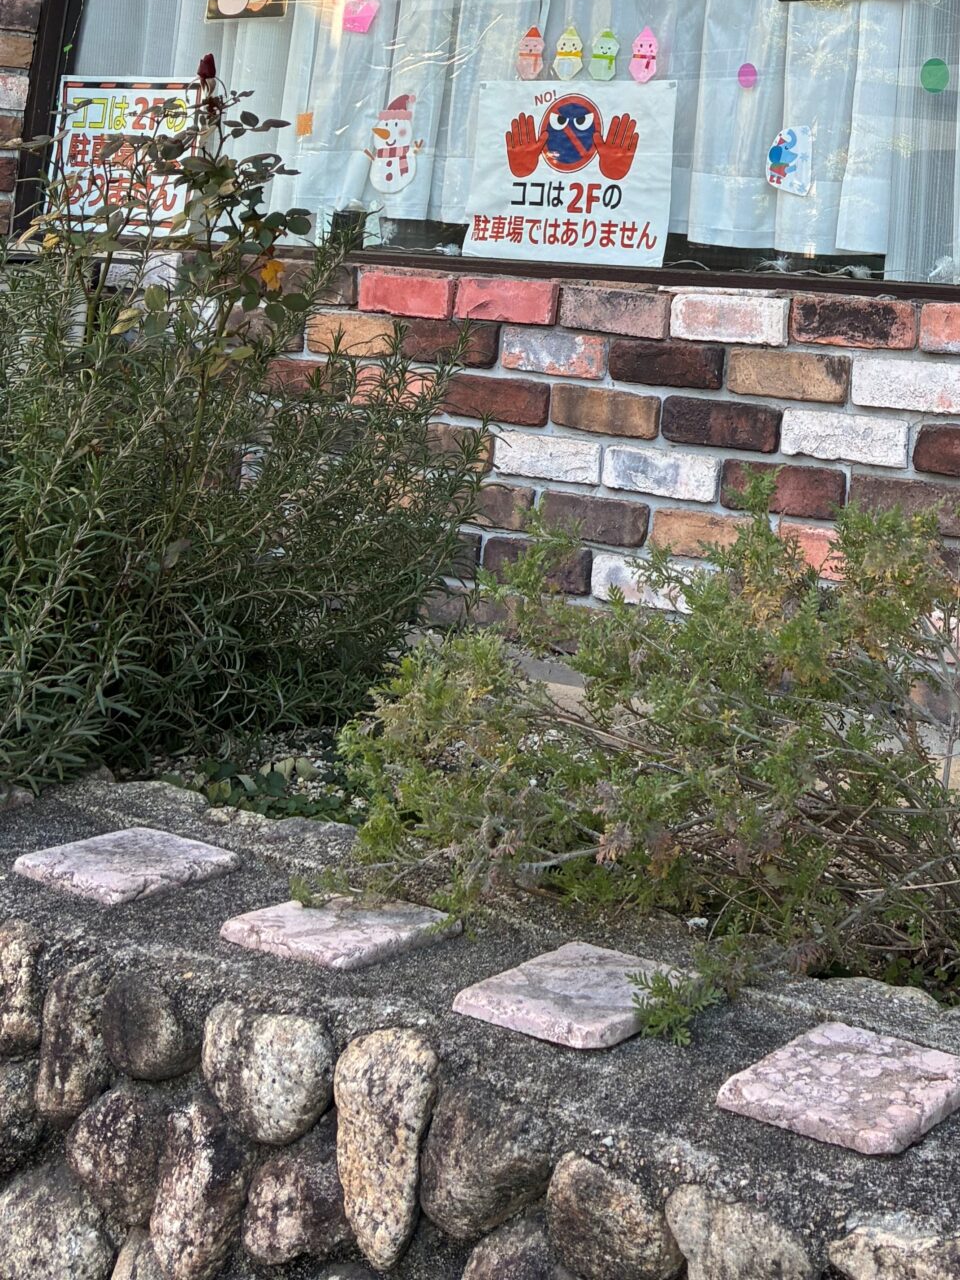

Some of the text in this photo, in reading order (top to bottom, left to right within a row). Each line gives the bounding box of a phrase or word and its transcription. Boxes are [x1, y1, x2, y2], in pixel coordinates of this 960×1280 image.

[534, 90, 558, 107] NO!
[510, 180, 622, 214] ココは2Fの
[471, 214, 658, 250] 駐車場ではありません
